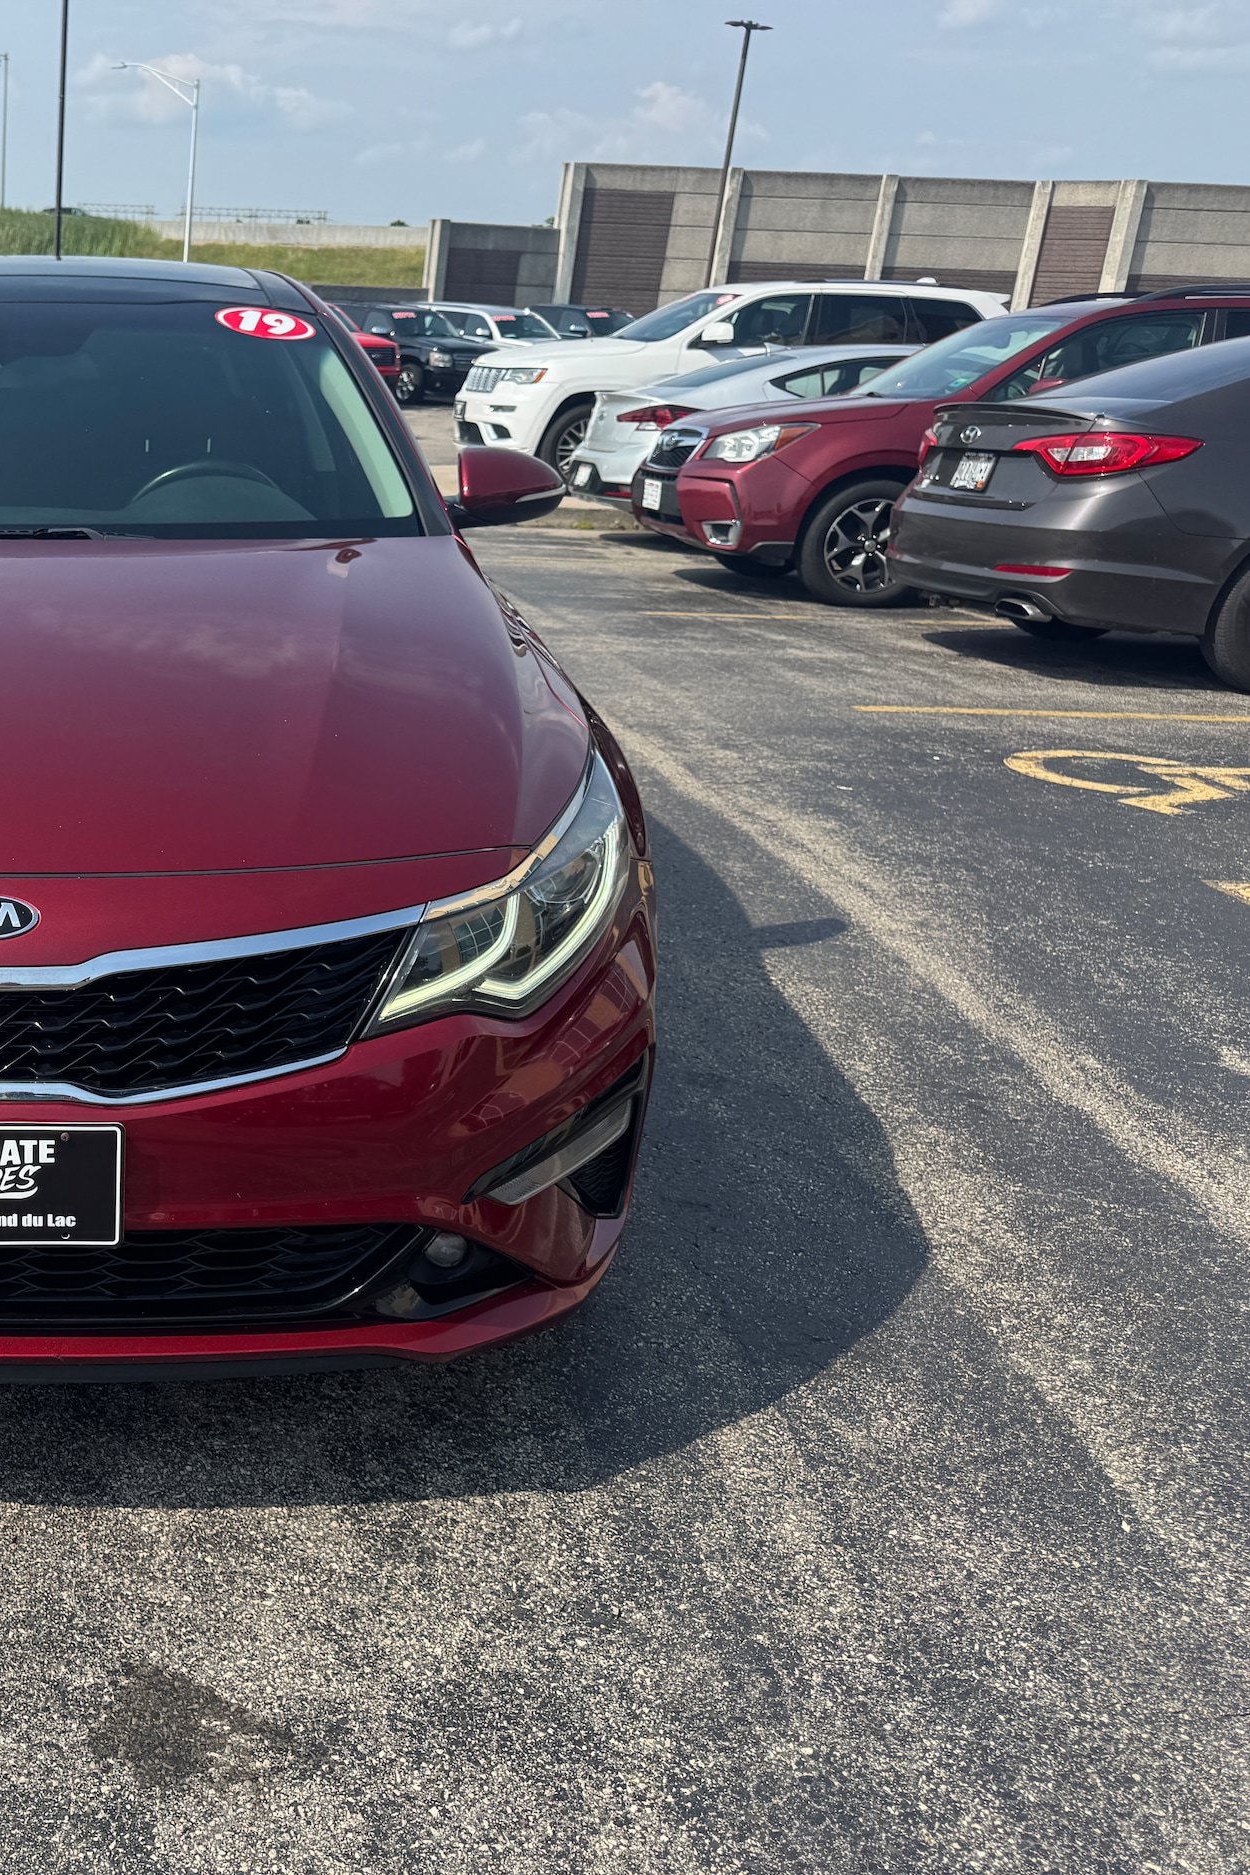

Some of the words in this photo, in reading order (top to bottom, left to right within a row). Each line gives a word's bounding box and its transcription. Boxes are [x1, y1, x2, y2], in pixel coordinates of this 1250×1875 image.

[238, 310, 297, 335] 19
[21, 1213, 44, 1227] du
[47, 1213, 77, 1227] Lac
